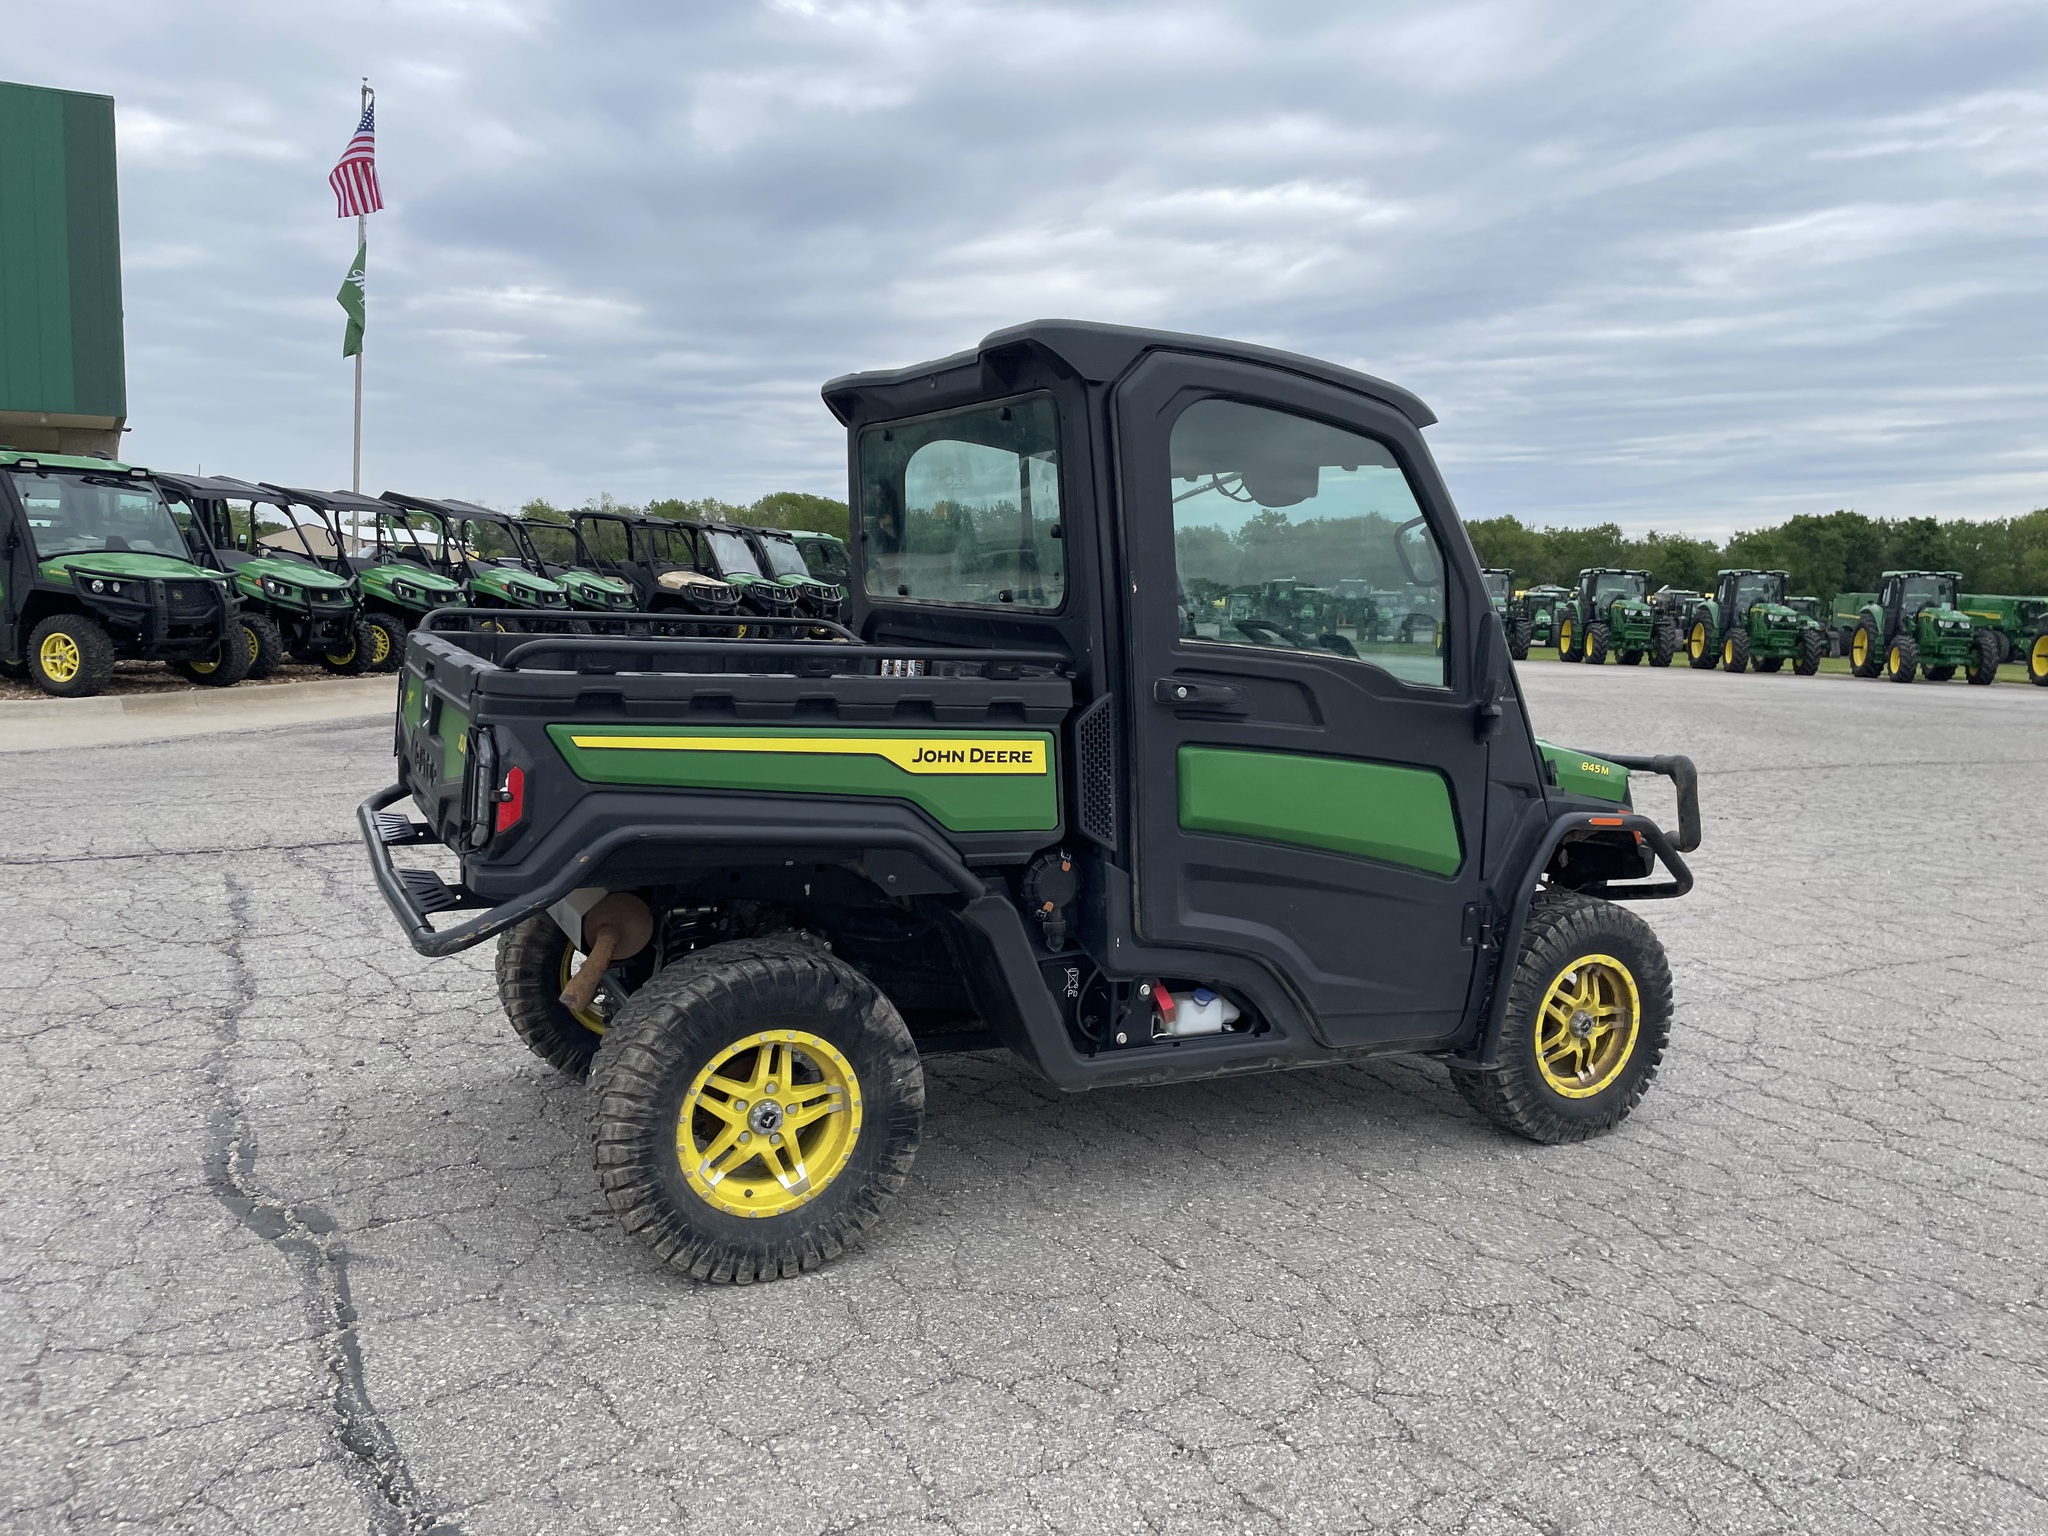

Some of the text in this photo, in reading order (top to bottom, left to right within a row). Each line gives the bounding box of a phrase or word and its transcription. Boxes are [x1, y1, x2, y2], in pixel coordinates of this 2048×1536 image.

[912, 747, 1033, 763] JOHN DEERE
[1581, 761, 1609, 775] 845M
[1067, 989, 1078, 998] Pb
